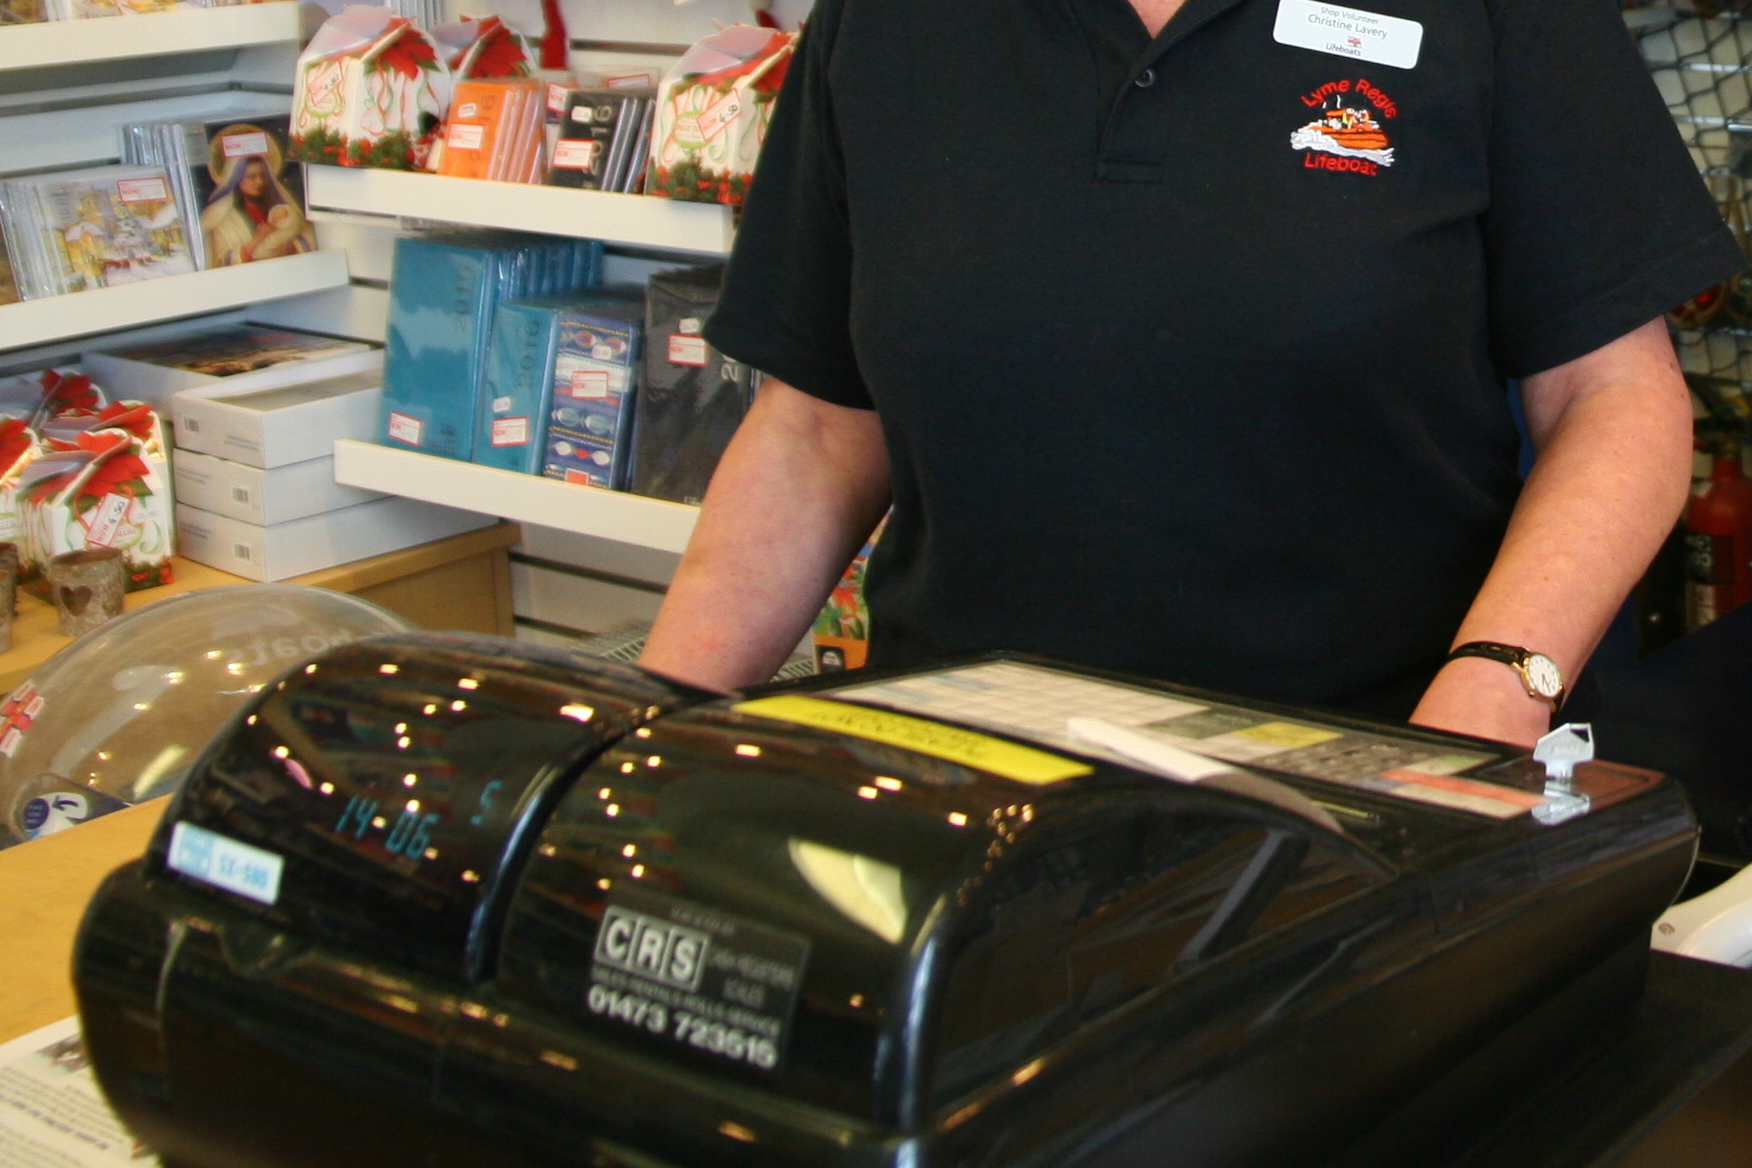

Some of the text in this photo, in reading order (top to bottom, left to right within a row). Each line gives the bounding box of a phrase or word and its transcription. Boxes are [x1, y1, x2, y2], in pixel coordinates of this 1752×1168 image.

[1308, 13, 1388, 40] Christine Lavery
[1320, 6, 1380, 25] Shop Volunteer
[1325, 42, 1362, 58] Lifeboats
[1300, 77, 1399, 120] Lyme Regis
[1303, 152, 1379, 177] Lifeboat
[604, 916, 699, 983] CRS
[587, 982, 670, 1034] 01473
